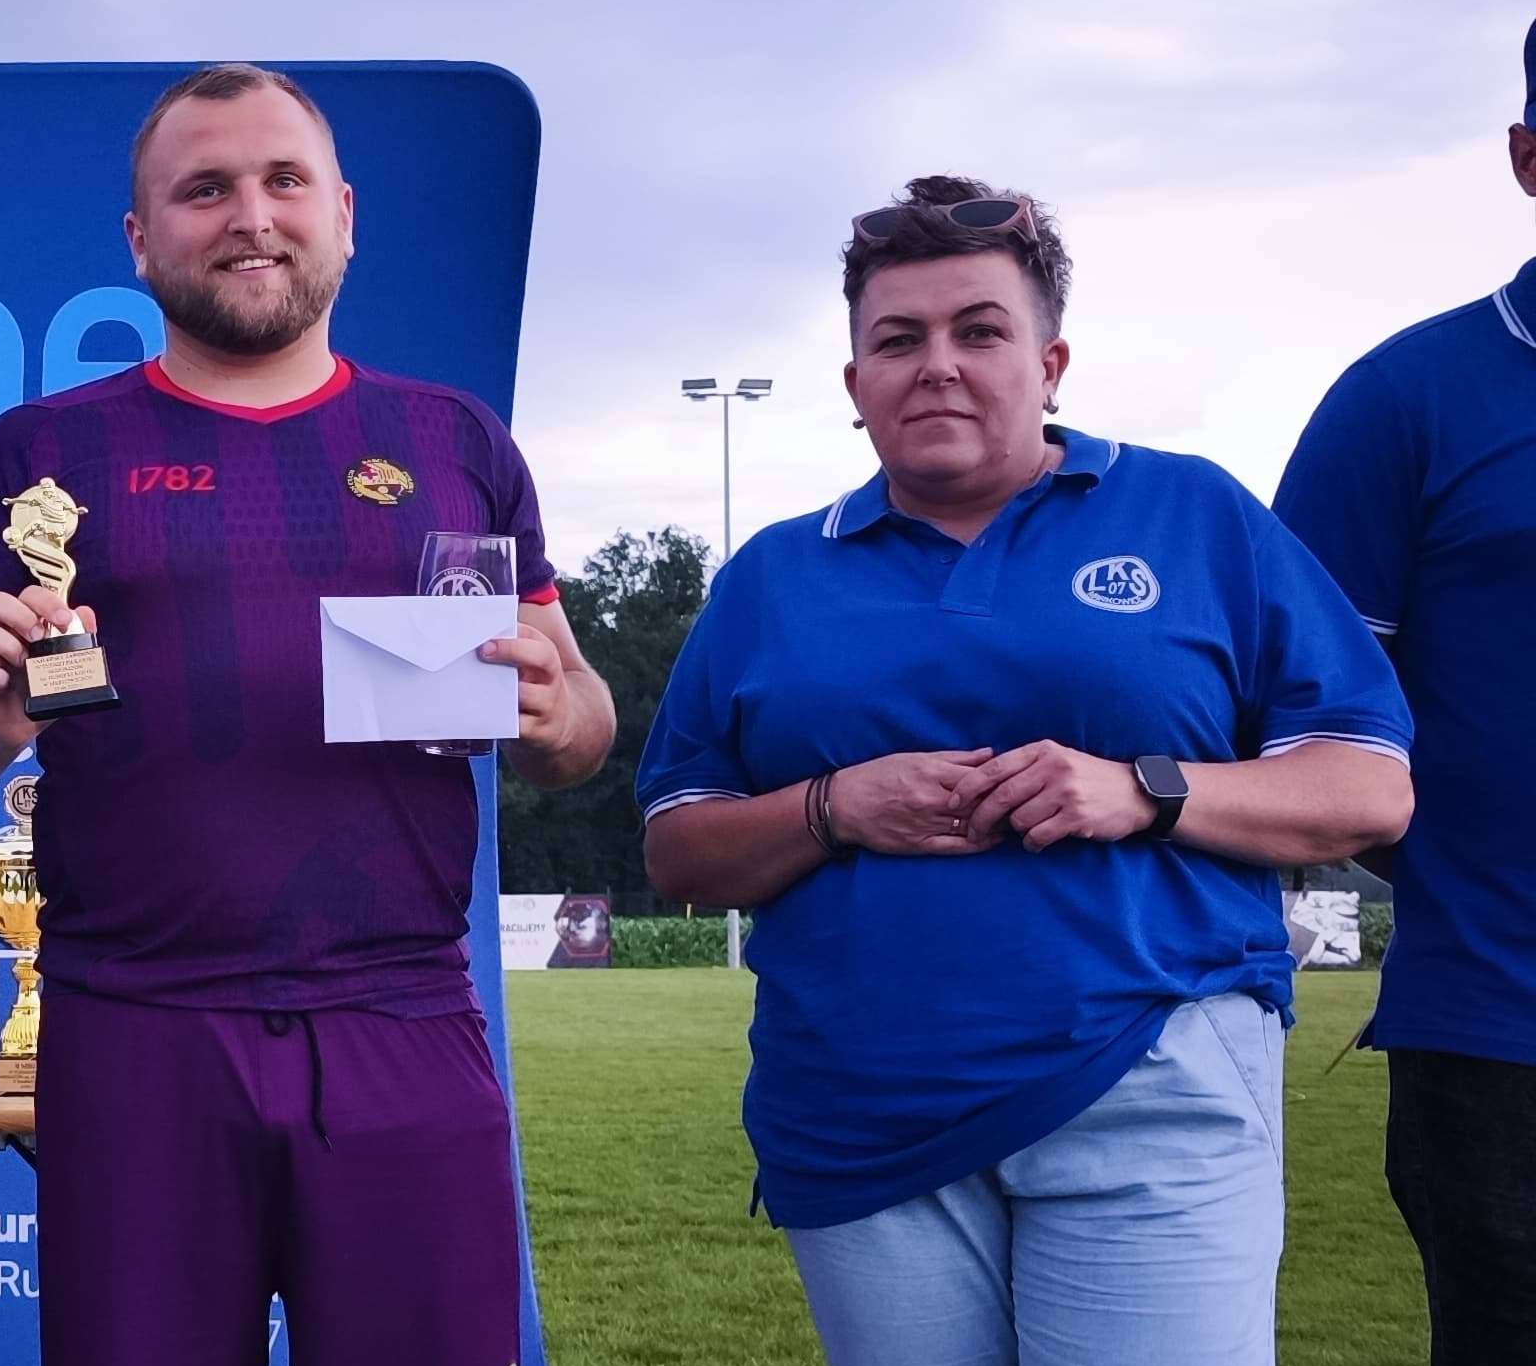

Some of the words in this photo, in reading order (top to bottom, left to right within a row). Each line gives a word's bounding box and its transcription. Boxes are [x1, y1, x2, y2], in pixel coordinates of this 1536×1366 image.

[129, 464, 216, 493] 1782
[1087, 562, 1148, 597] LKS
[1108, 581, 1126, 595] 07
